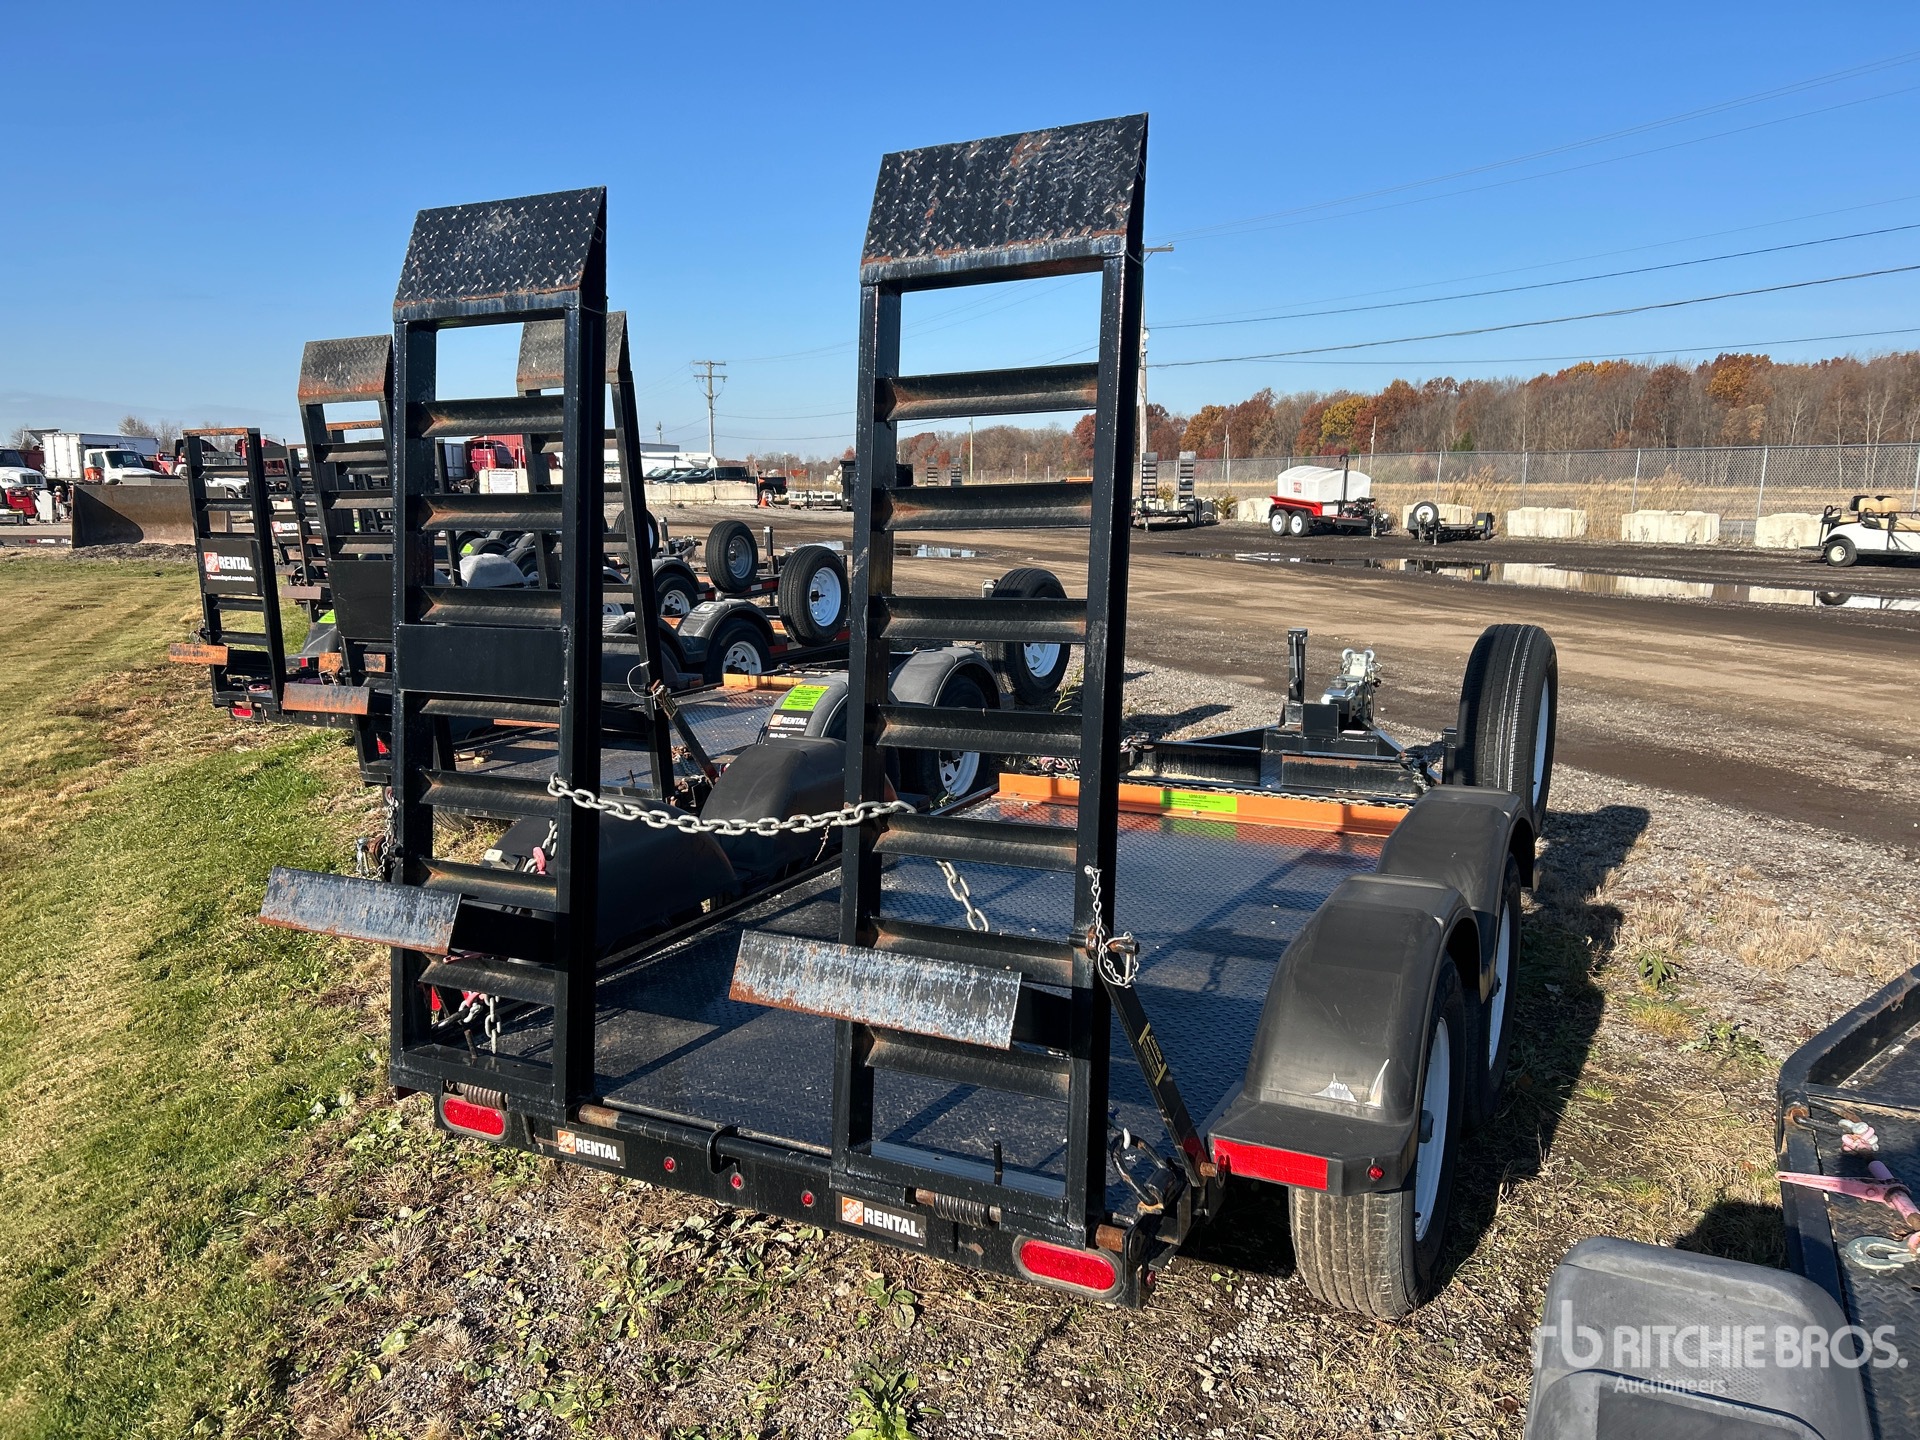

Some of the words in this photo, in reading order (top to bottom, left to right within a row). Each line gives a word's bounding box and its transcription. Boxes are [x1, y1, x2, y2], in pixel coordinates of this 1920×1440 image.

[218, 556, 252, 570] RENTAL
[781, 717, 807, 726] RENTAL
[575, 1137, 621, 1162] RENTAL
[864, 1207, 920, 1238] RENTAL
